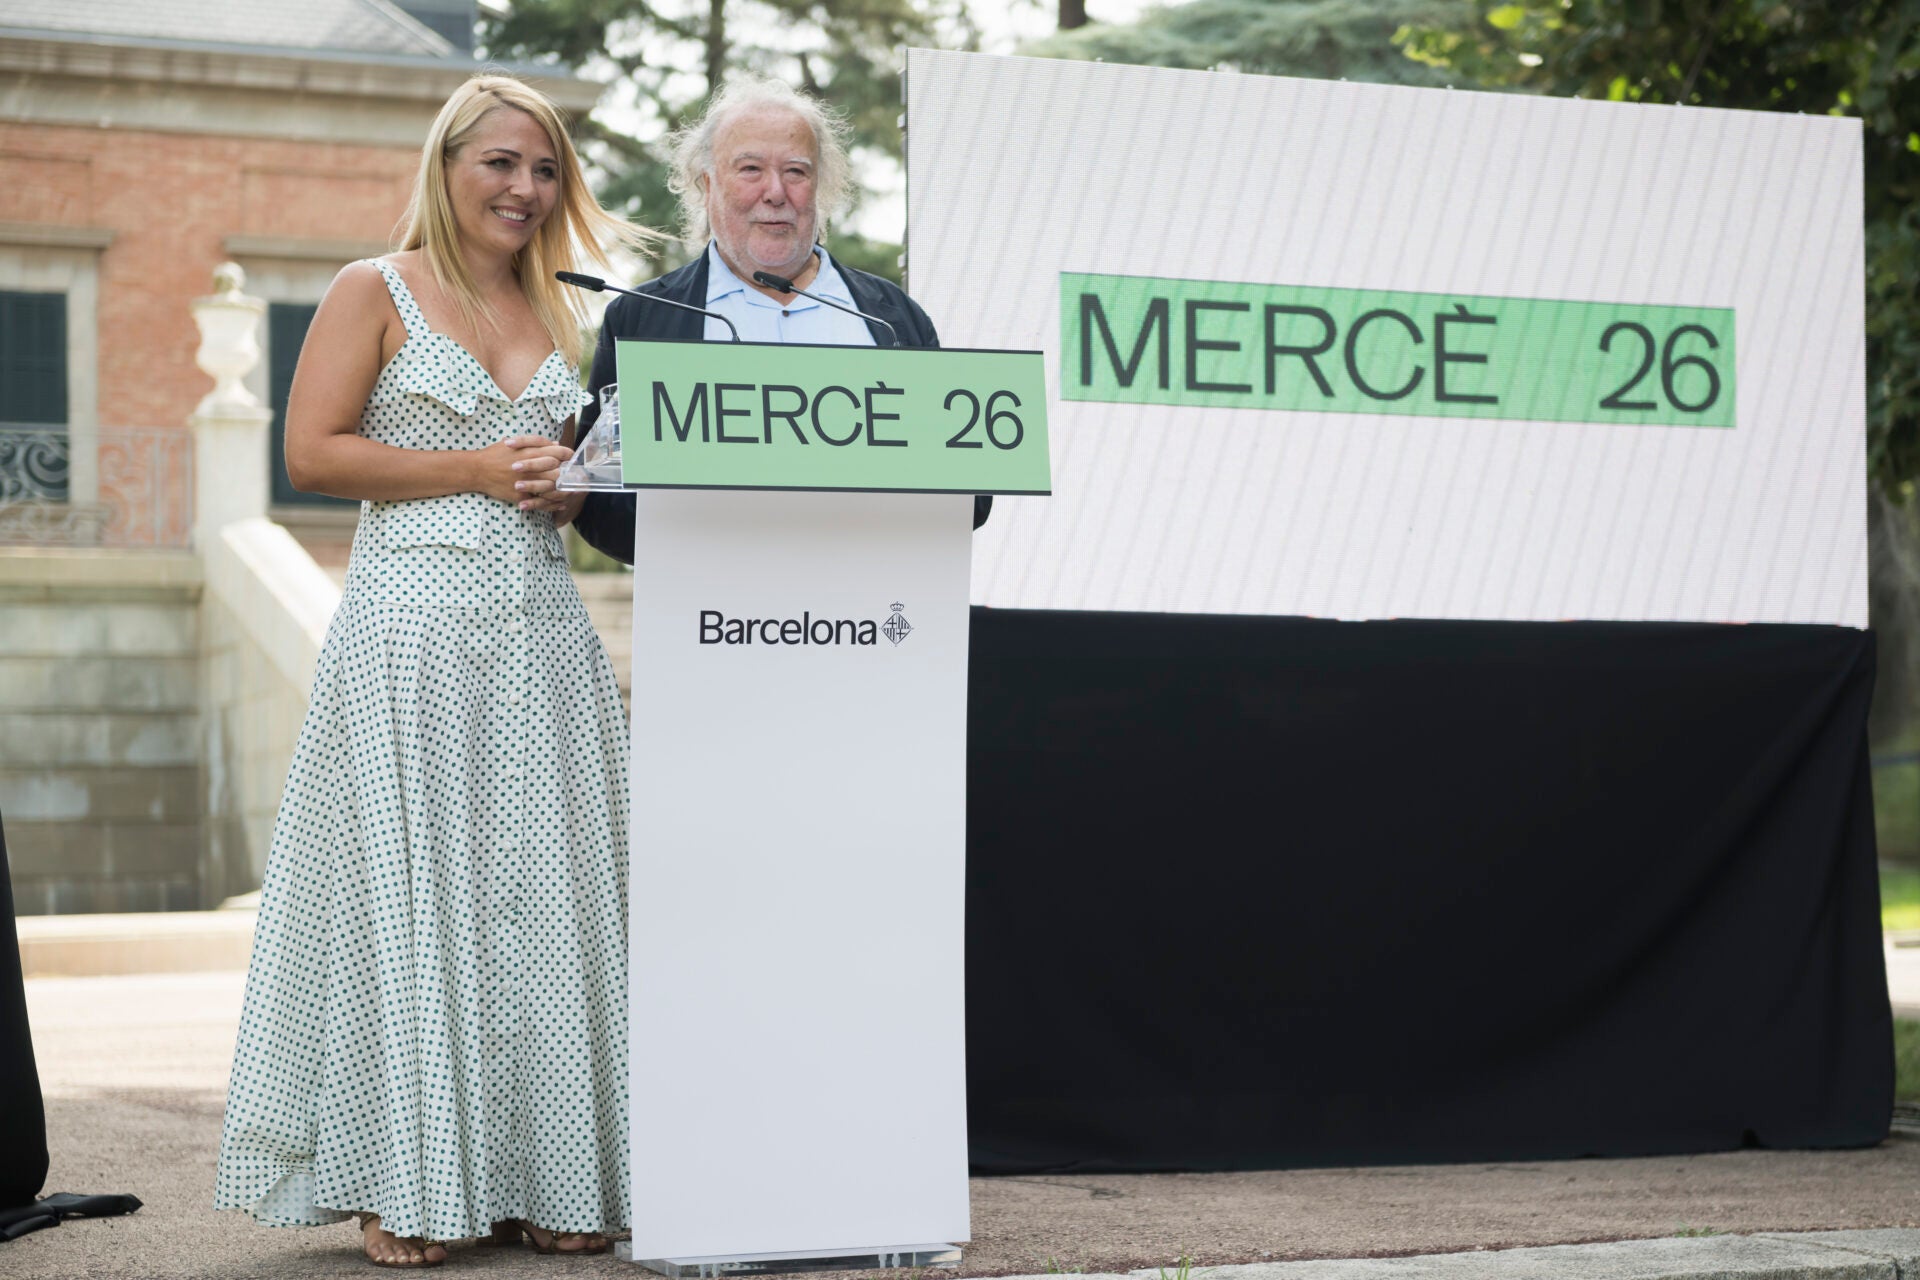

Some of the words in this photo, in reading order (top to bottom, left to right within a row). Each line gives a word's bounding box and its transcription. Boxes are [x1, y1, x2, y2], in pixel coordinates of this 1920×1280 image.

[1079, 293, 1499, 404] MERCÈ
[1598, 321, 1722, 413] 26
[652, 381, 909, 447] MERCÈ
[943, 388, 1025, 450] 26
[699, 610, 877, 646] Barcelona
